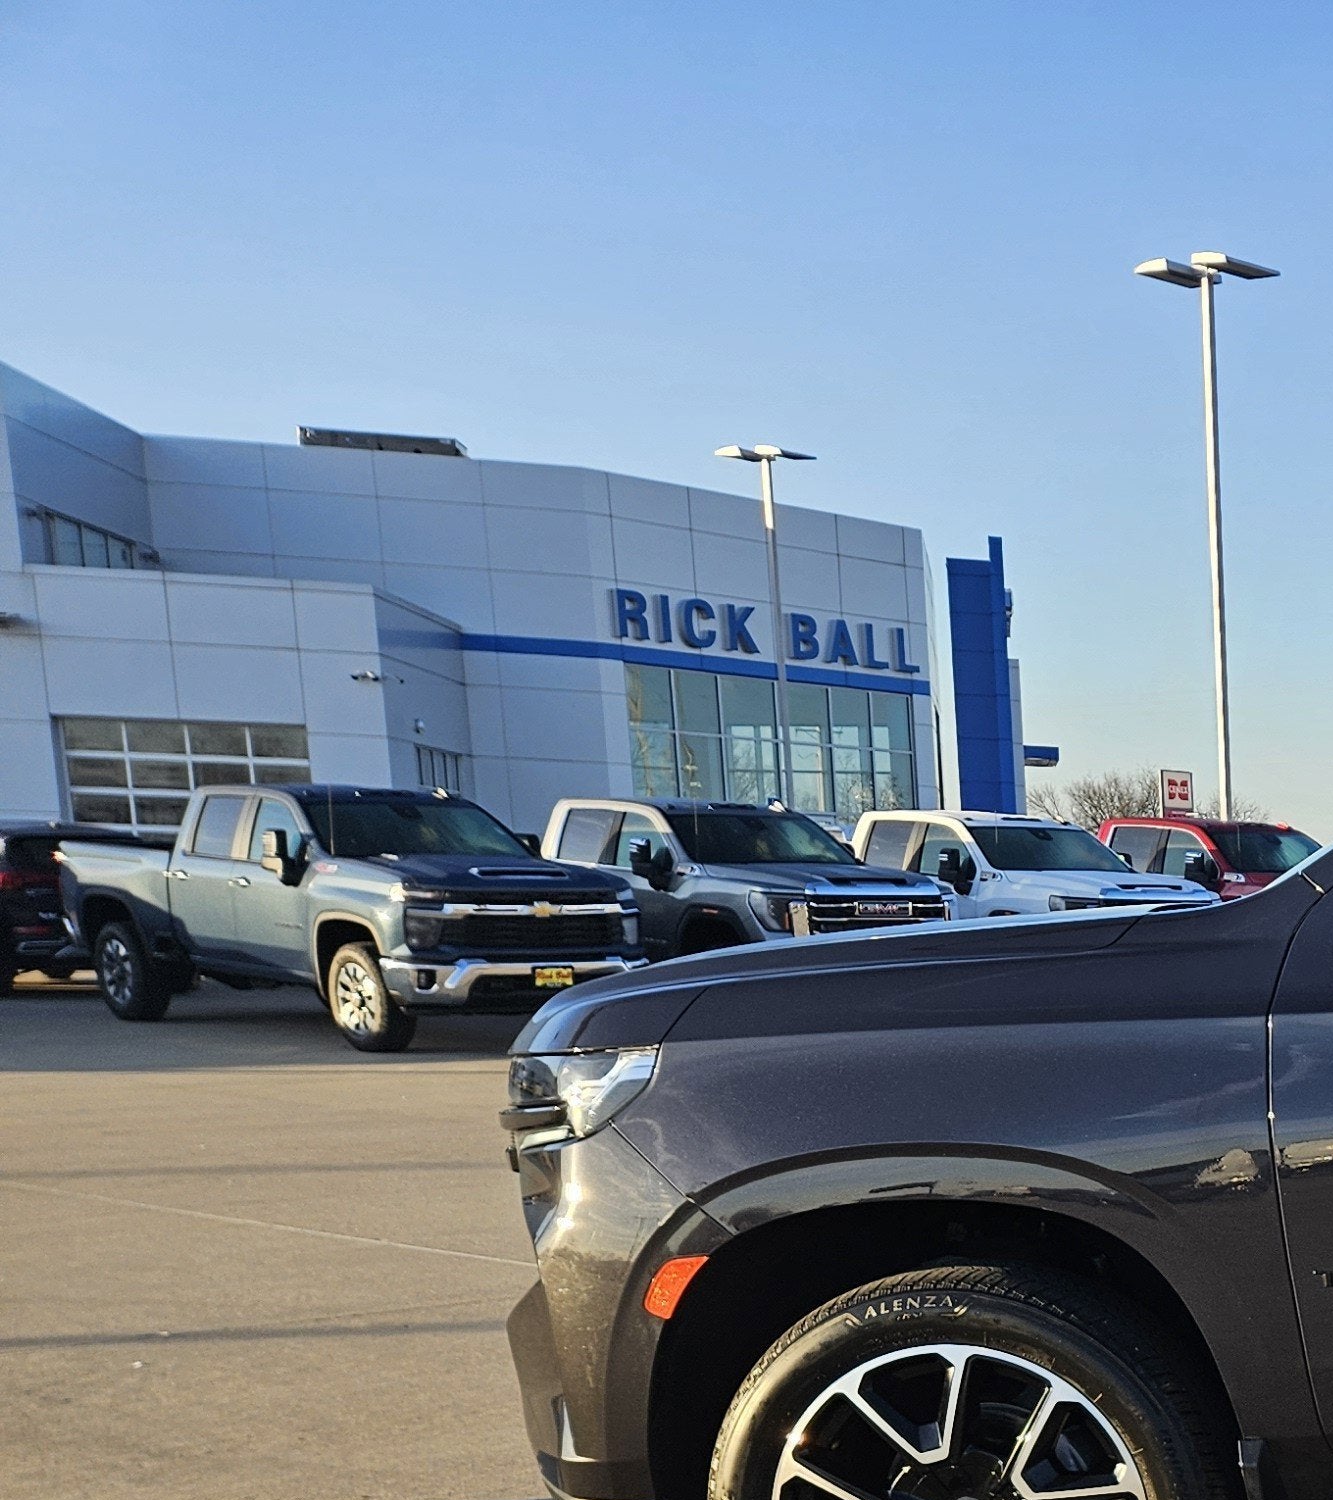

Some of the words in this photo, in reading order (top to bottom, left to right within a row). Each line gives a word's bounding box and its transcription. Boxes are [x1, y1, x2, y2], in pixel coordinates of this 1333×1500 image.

[608, 587, 761, 654] RICK
[785, 611, 920, 673] BALL
[864, 1295, 954, 1320] ALENZA
